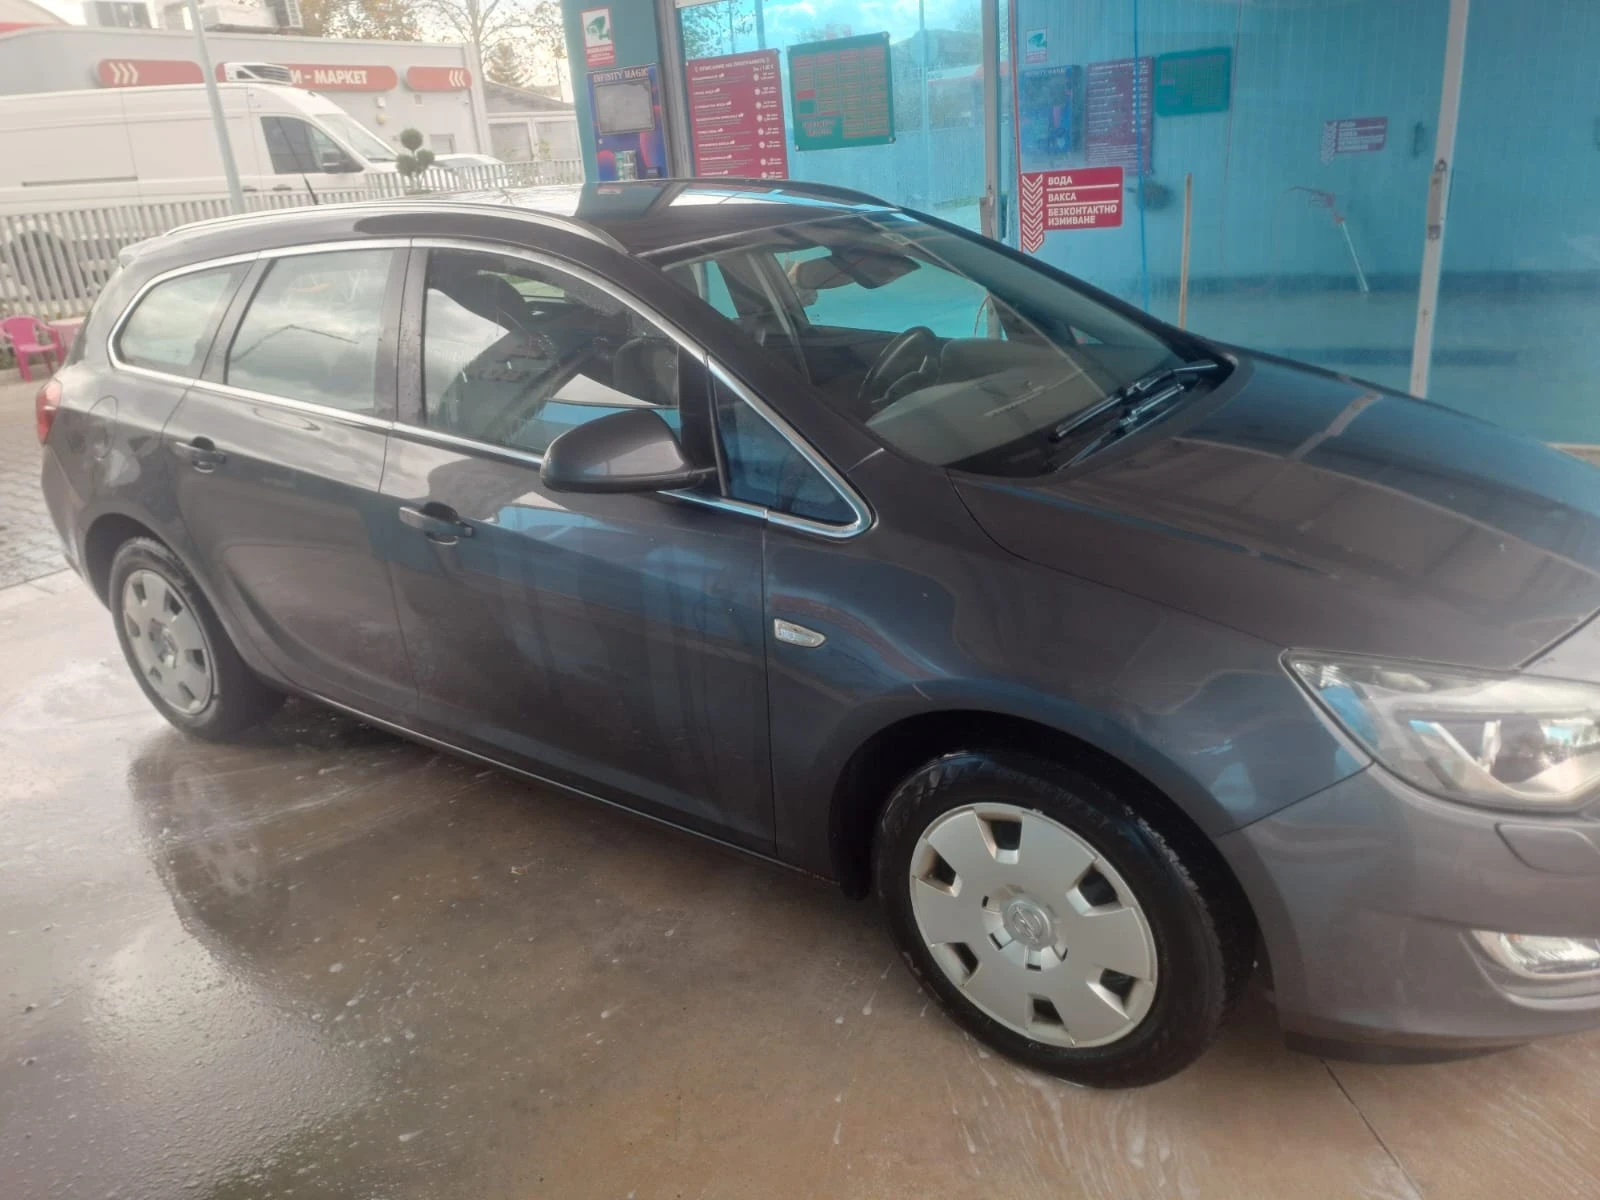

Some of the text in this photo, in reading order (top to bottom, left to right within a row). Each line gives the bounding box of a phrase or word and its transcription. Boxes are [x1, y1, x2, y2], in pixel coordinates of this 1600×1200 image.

[313, 69, 368, 85] МАРКЕТ
[1047, 175, 1073, 186] ВОДА
[1047, 192, 1077, 202] ВАКСА
[1047, 204, 1118, 217] БЕЗКОНТАКТНО
[1047, 215, 1096, 226] ИЗМИВАНЕ
